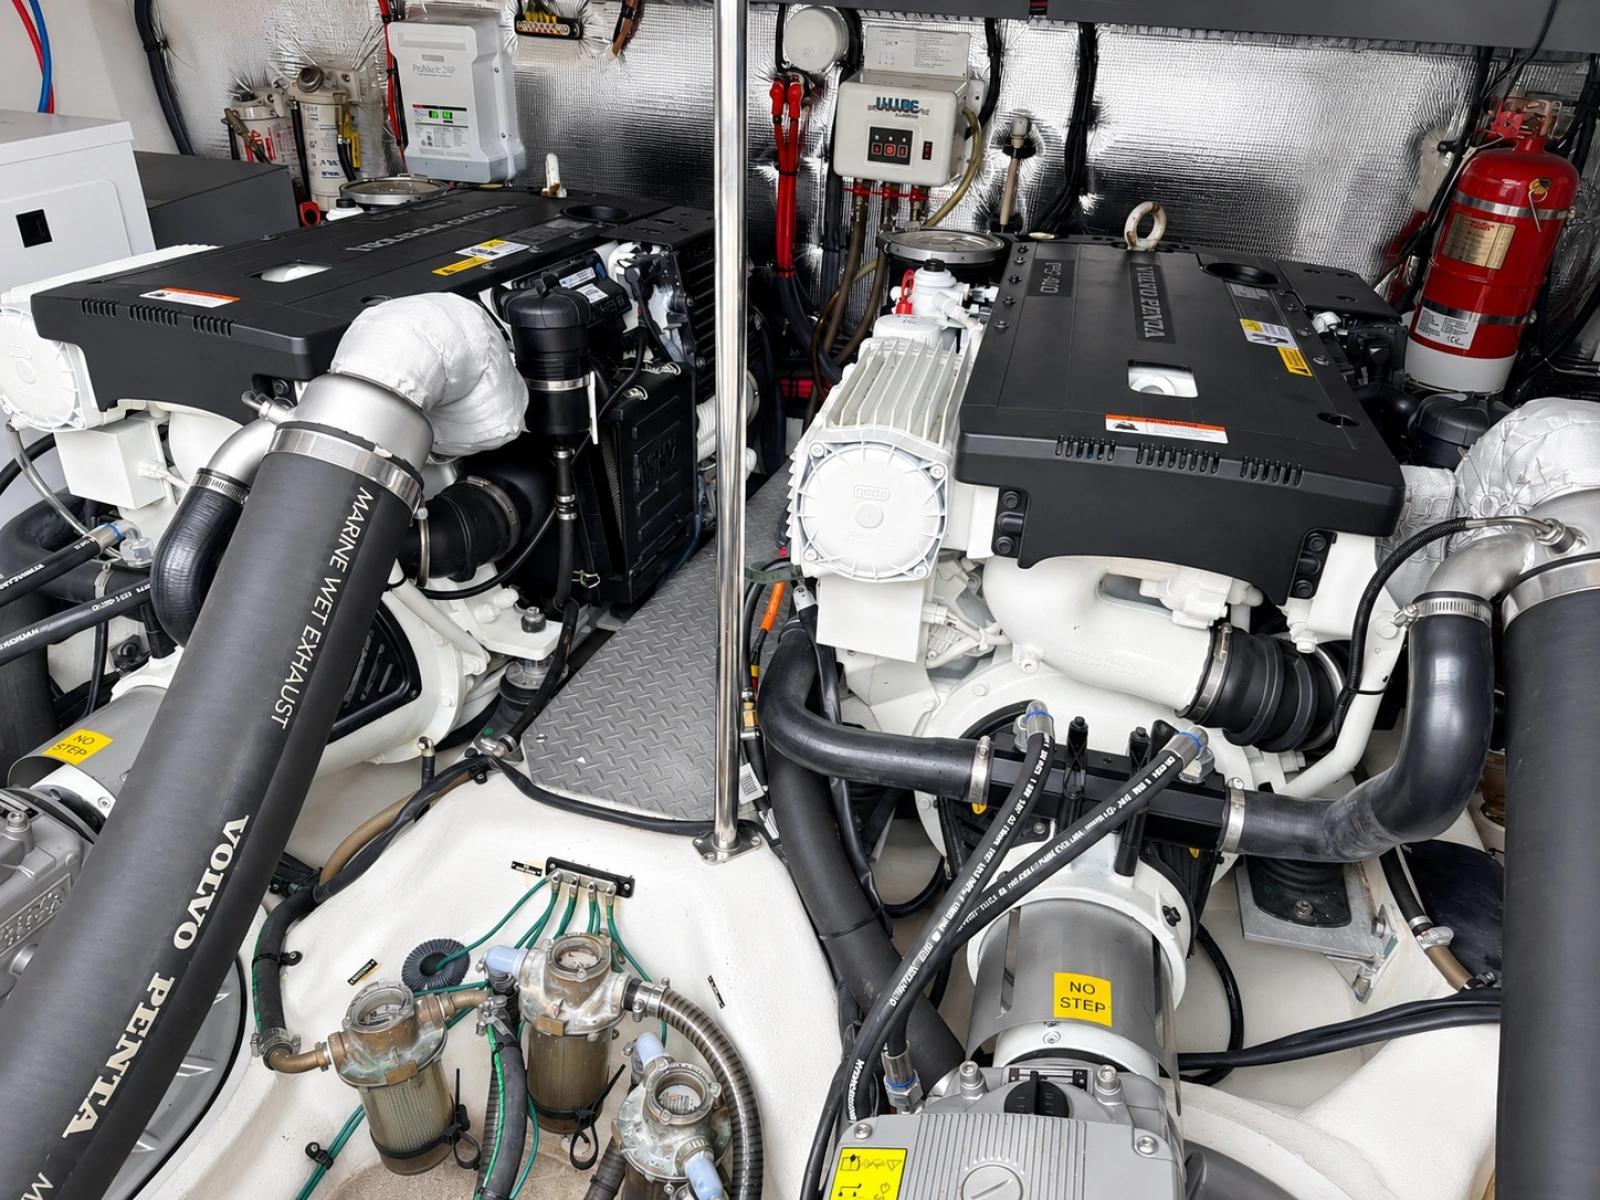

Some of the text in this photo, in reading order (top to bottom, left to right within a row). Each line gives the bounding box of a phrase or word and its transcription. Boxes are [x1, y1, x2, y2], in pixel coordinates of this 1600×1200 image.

[271, 486, 374, 729] MARINE WET EXHAUST
[72, 734, 96, 746] NO
[52, 743, 88, 756] STEP
[61, 814, 250, 1139] VOLVO PENTA
[1069, 980, 1096, 995] NO
[1059, 996, 1106, 1013] STEP
